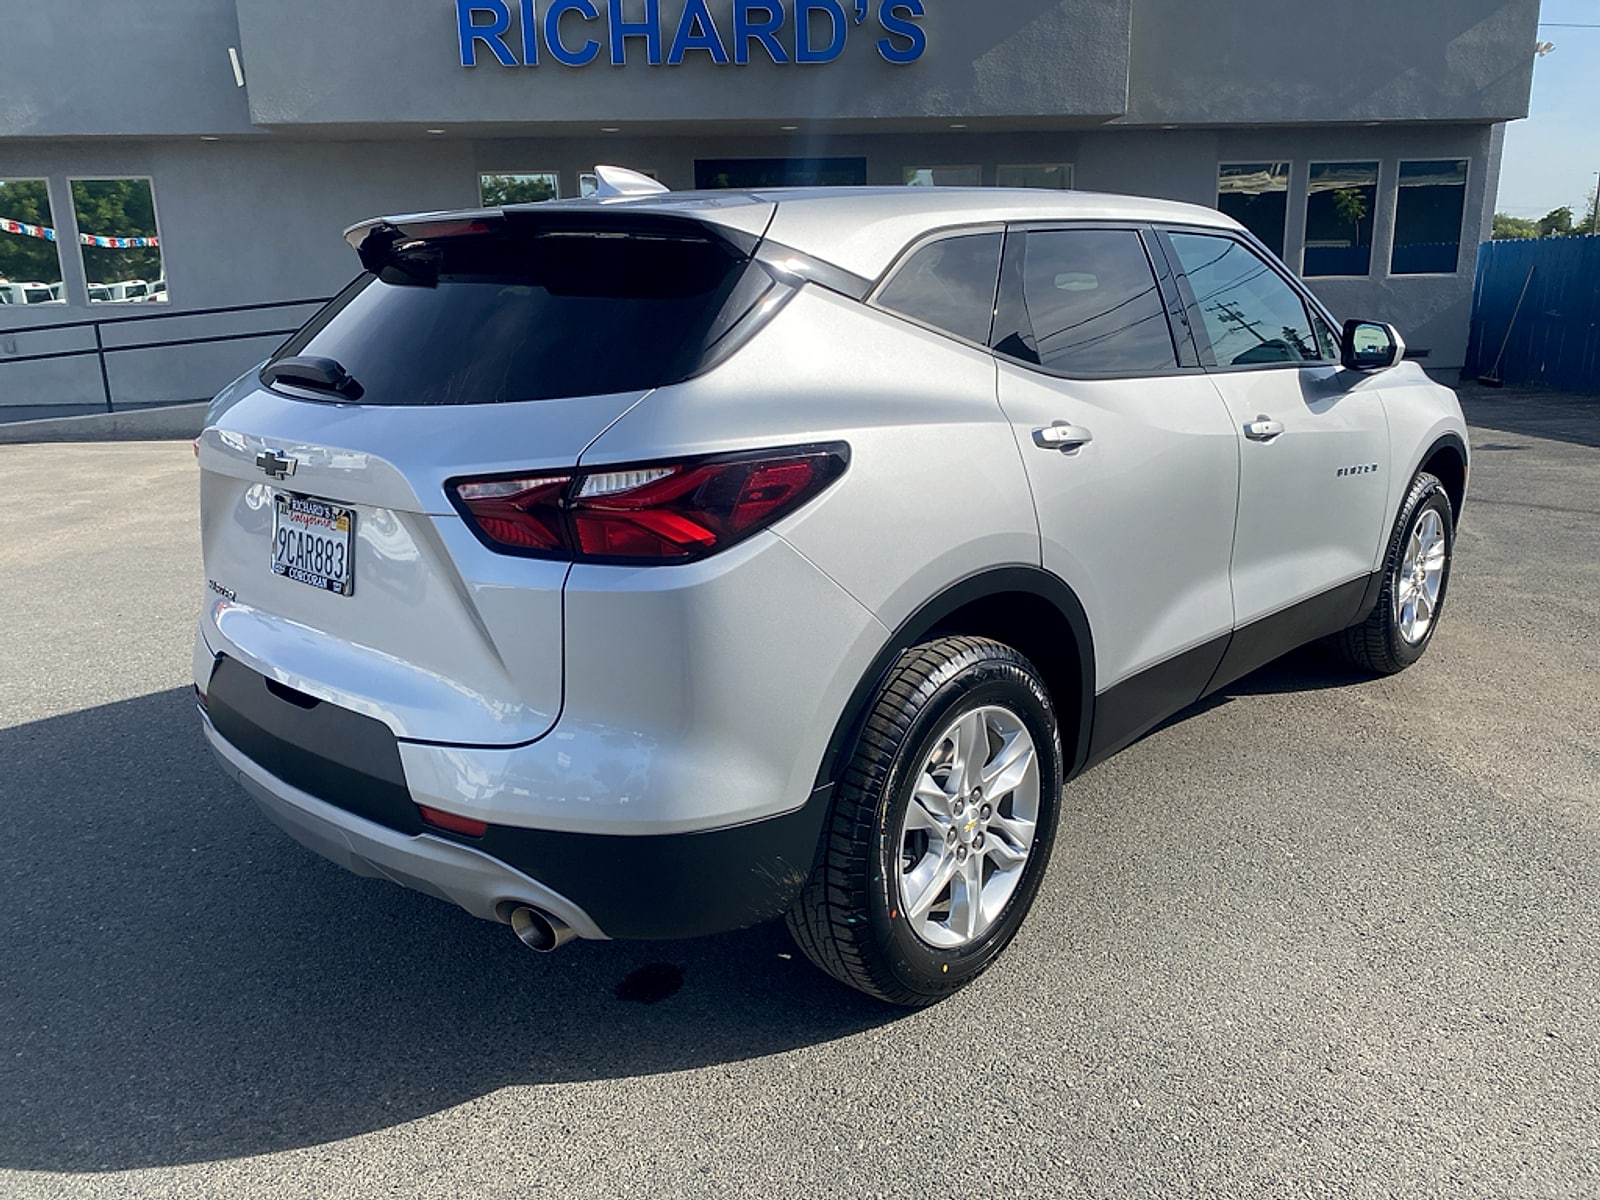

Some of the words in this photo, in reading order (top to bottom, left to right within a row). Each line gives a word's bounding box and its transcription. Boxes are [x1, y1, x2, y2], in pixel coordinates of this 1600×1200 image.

[456, 0, 927, 67] RICHARD'S
[278, 527, 344, 579] 9CAR883
[288, 567, 327, 589] CORCORAN
